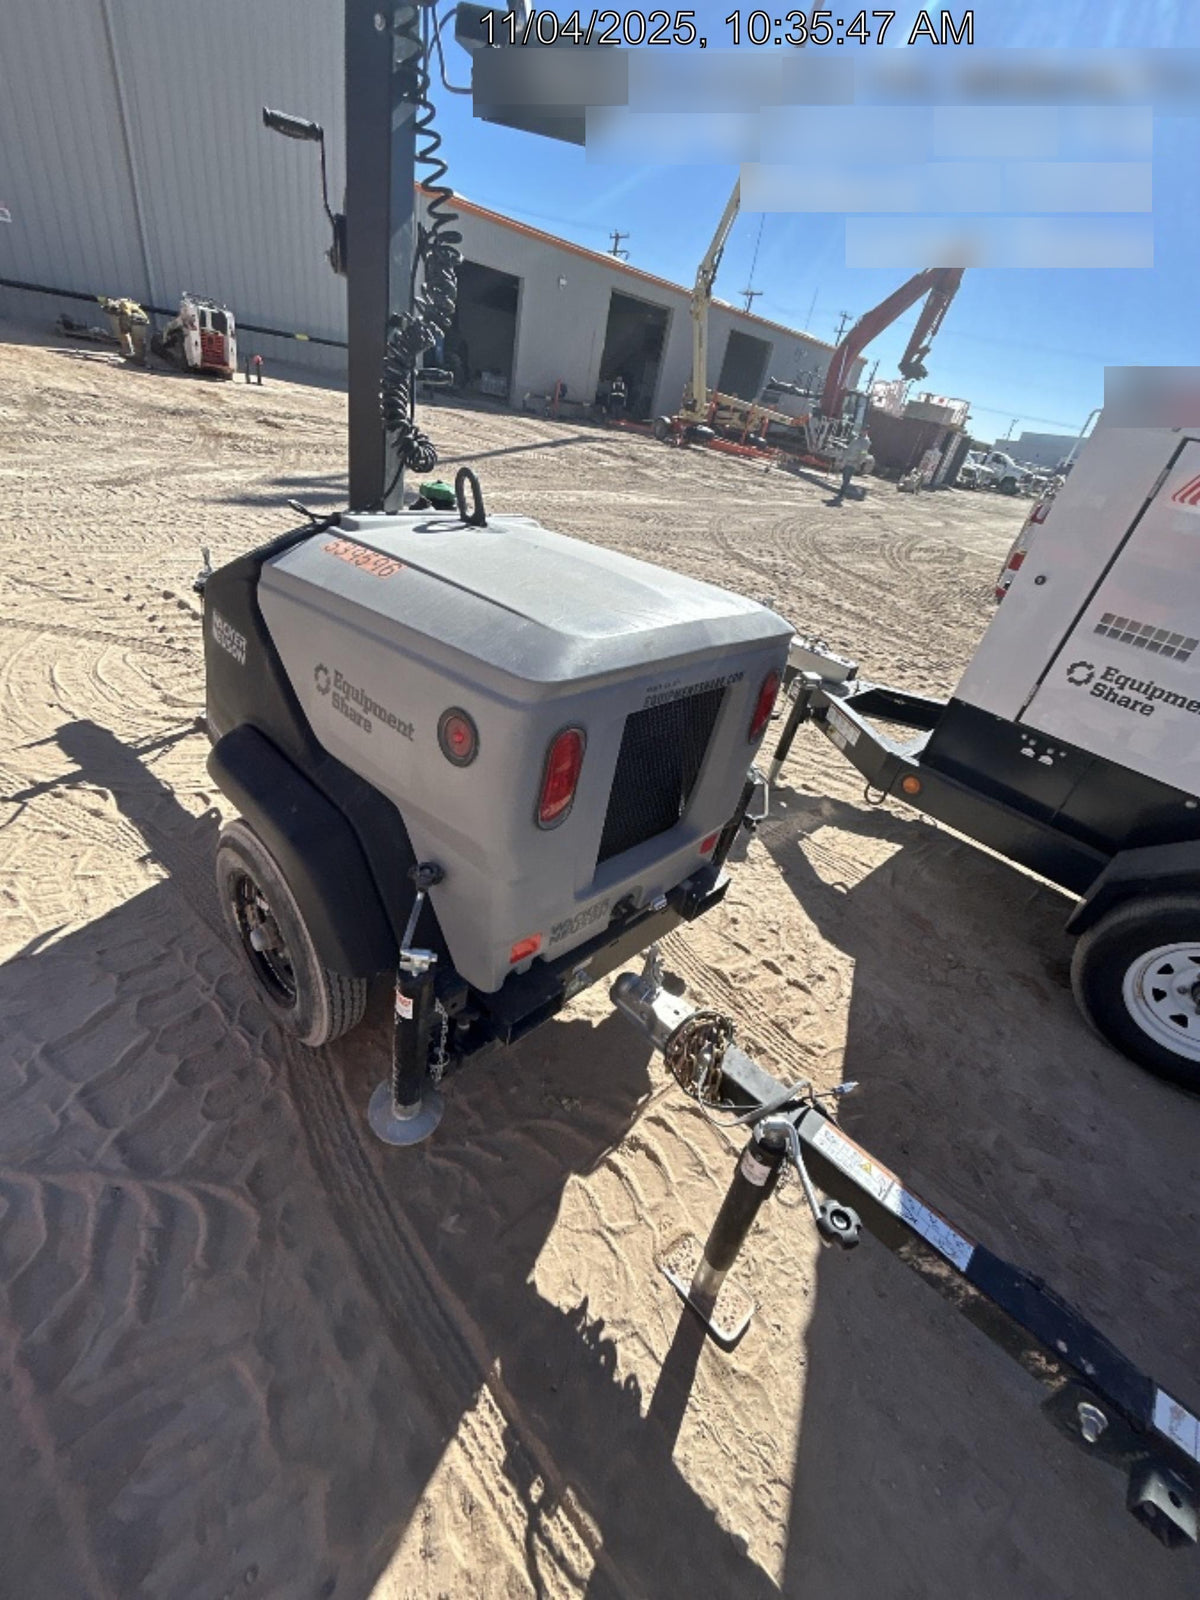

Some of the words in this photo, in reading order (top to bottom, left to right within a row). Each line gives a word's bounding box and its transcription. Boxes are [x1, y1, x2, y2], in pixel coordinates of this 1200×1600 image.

[331, 691, 373, 734] Share
[332, 668, 416, 742] Equipment
[1089, 681, 1156, 717] Share
[1099, 665, 1200, 716] Equipme
